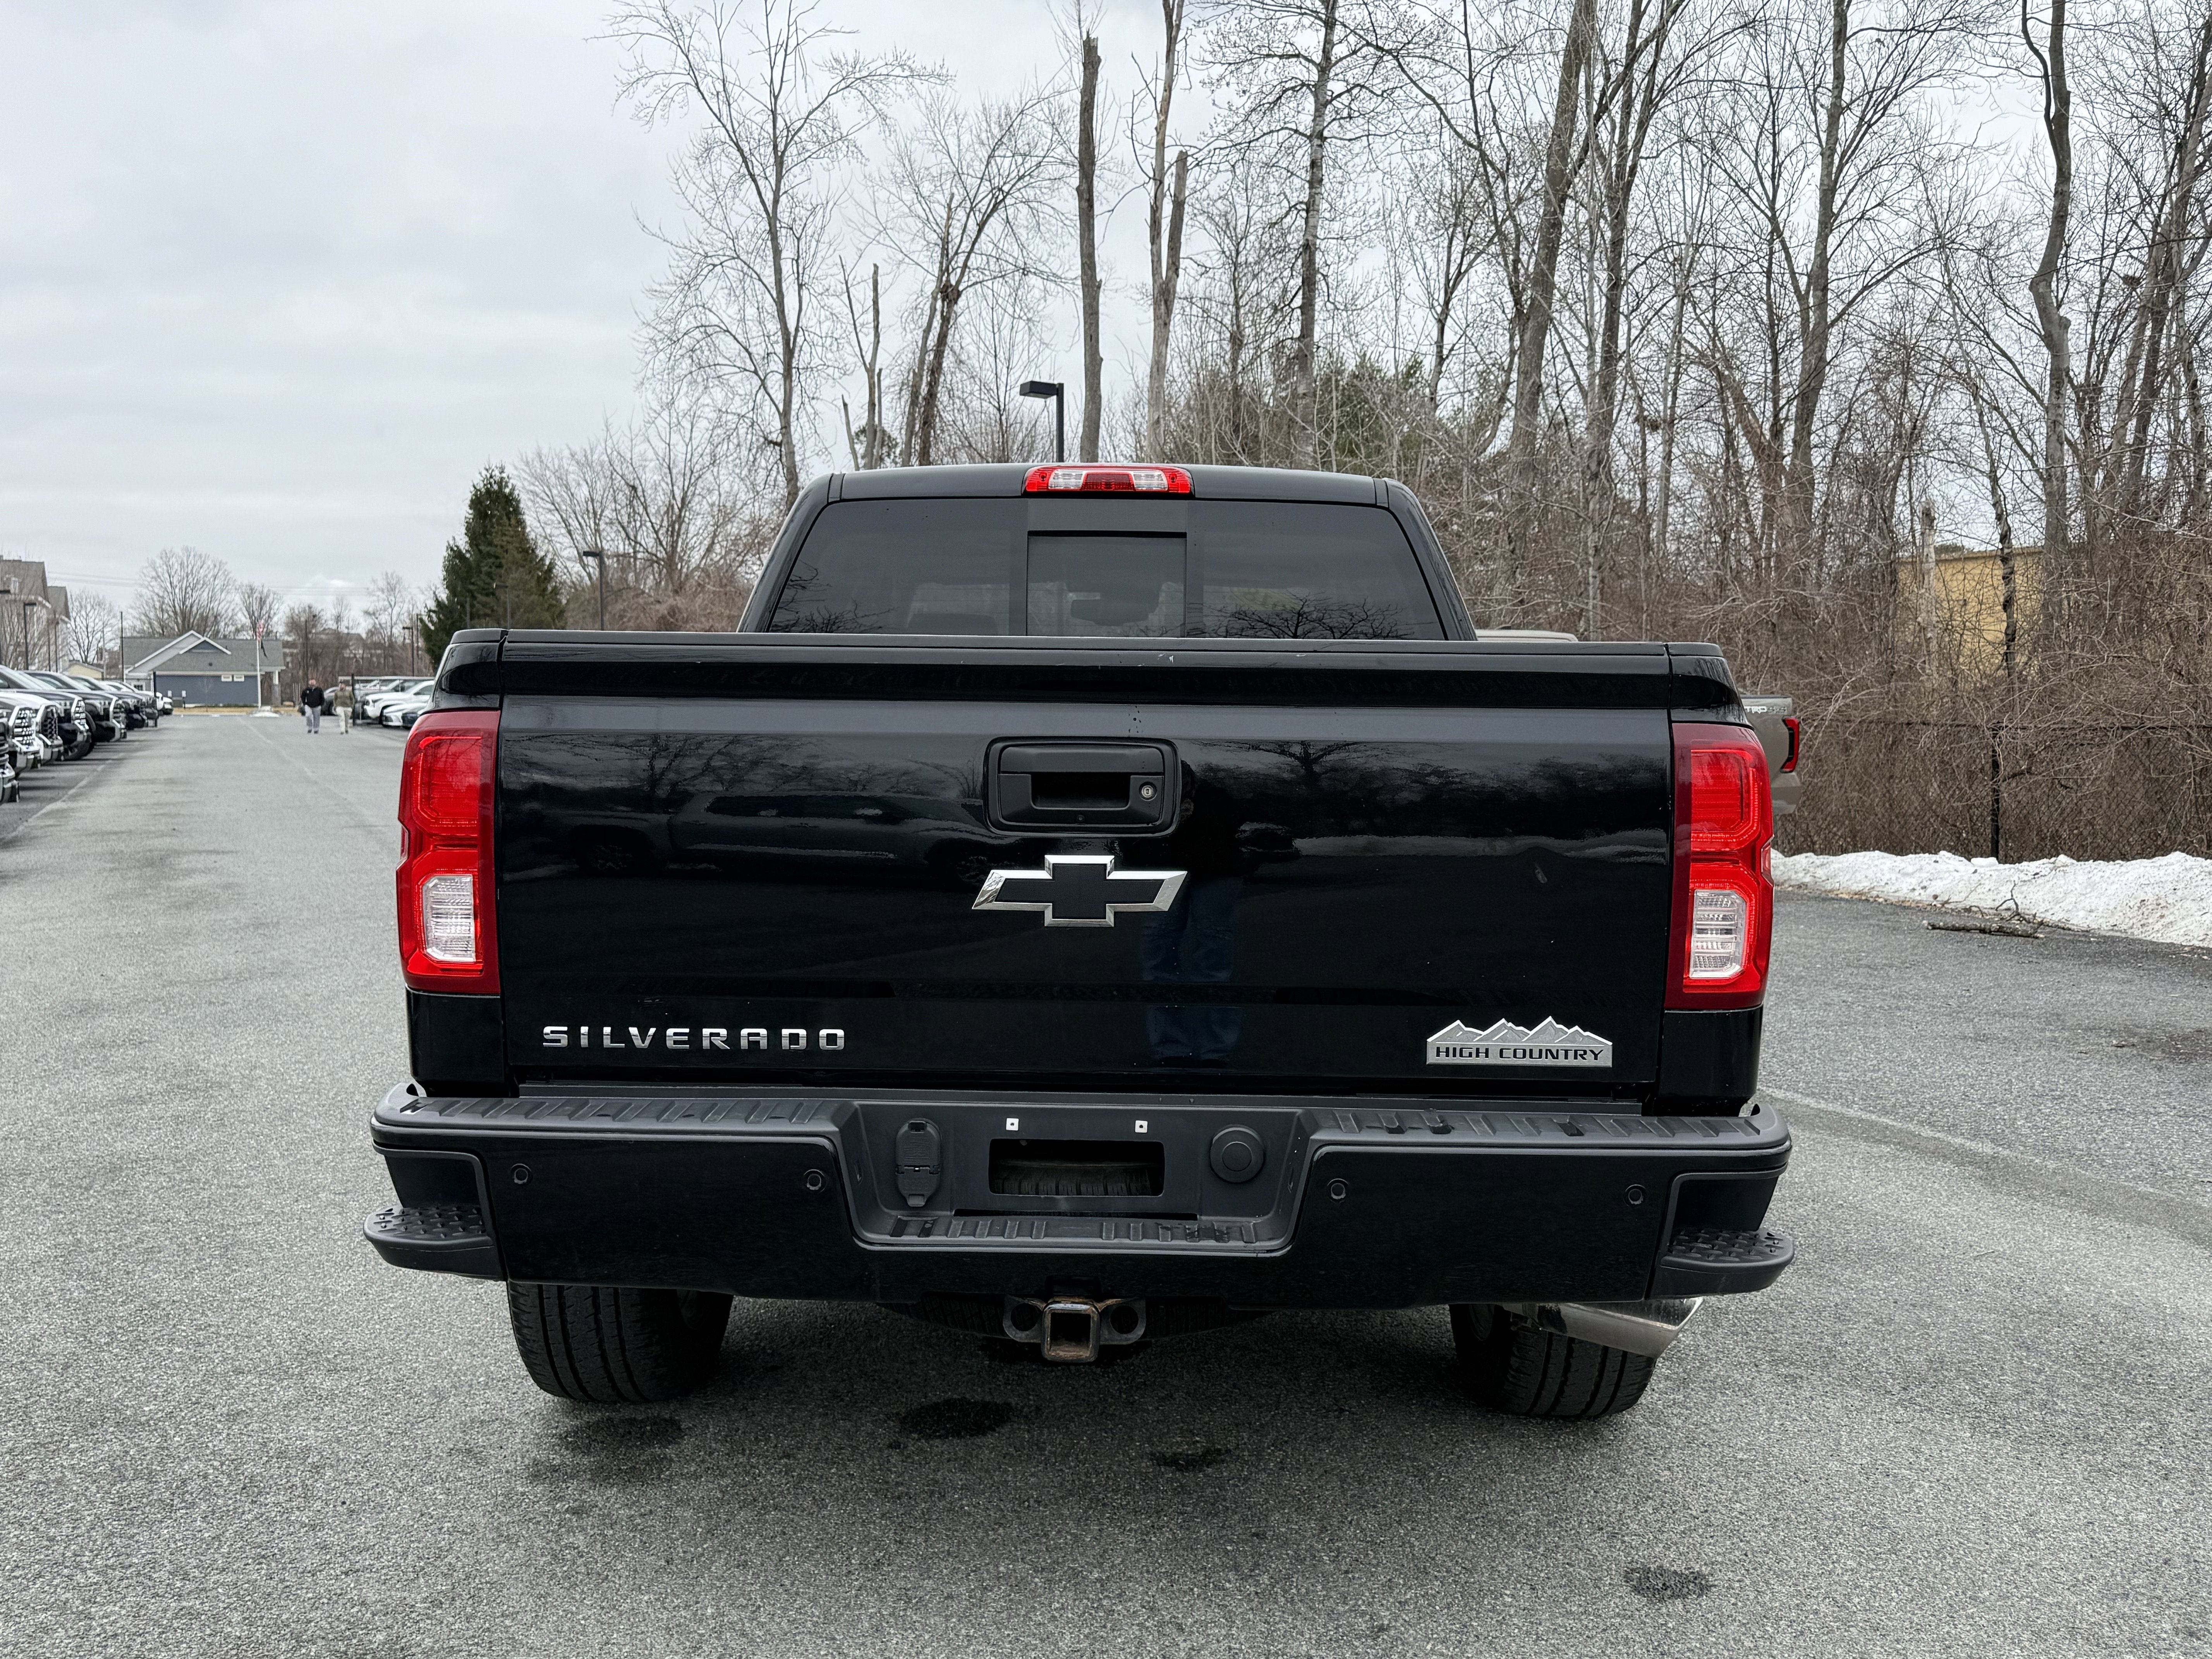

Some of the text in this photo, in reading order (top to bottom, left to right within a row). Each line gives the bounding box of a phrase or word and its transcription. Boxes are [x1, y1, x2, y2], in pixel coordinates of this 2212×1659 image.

[543, 1026, 845, 1050] SILVERADO
[1436, 1047, 1604, 1060] HIGH COUNTRY
